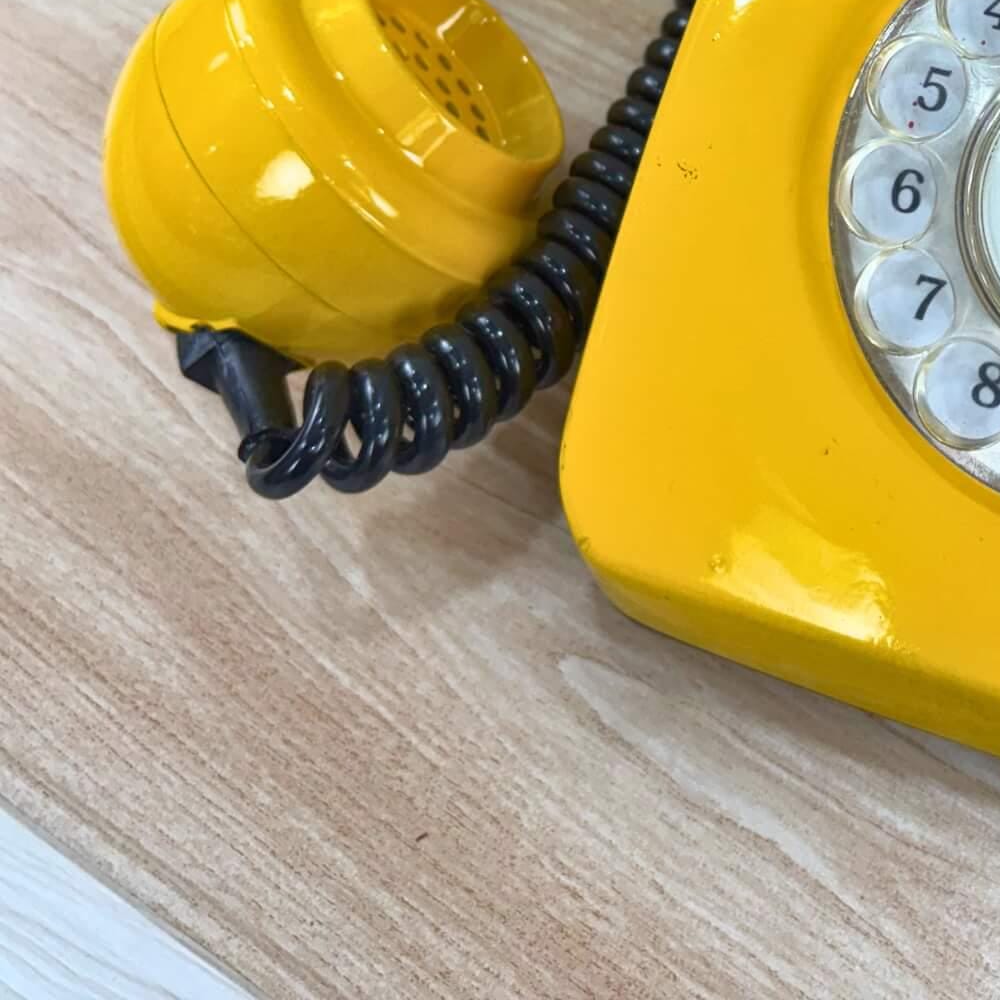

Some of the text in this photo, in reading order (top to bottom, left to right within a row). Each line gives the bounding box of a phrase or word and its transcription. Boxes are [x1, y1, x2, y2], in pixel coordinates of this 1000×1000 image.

[916, 67, 953, 111] 5
[891, 169, 924, 213] 6
[915, 274, 947, 320] 7
